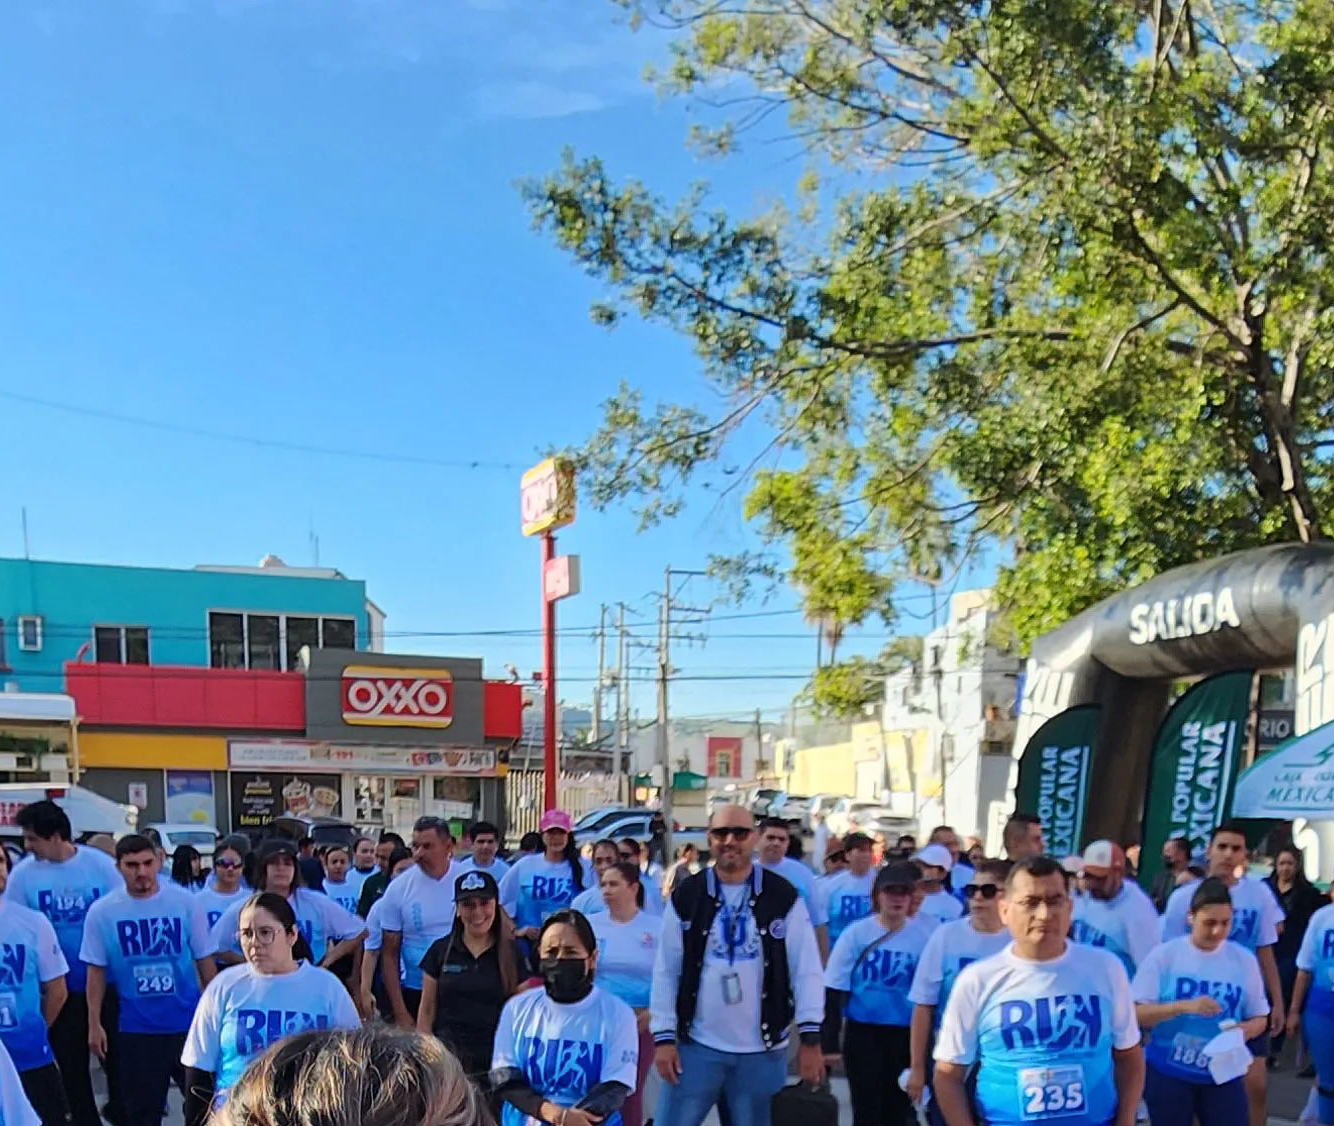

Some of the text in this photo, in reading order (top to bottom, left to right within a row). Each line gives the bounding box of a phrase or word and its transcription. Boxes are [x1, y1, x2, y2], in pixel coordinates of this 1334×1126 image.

[1128, 587, 1240, 645] SALIDA
[348, 678, 447, 717] OXXO
[1170, 721, 1202, 823] POPULAR
[1189, 721, 1228, 858] EXICANA
[1054, 746, 1082, 857] EXICANA
[116, 917, 182, 957] RUN
[138, 975, 174, 992] 249
[1000, 994, 1102, 1051] RUN
[524, 1037, 603, 1096] RUN
[1025, 1083, 1083, 1114] 235
